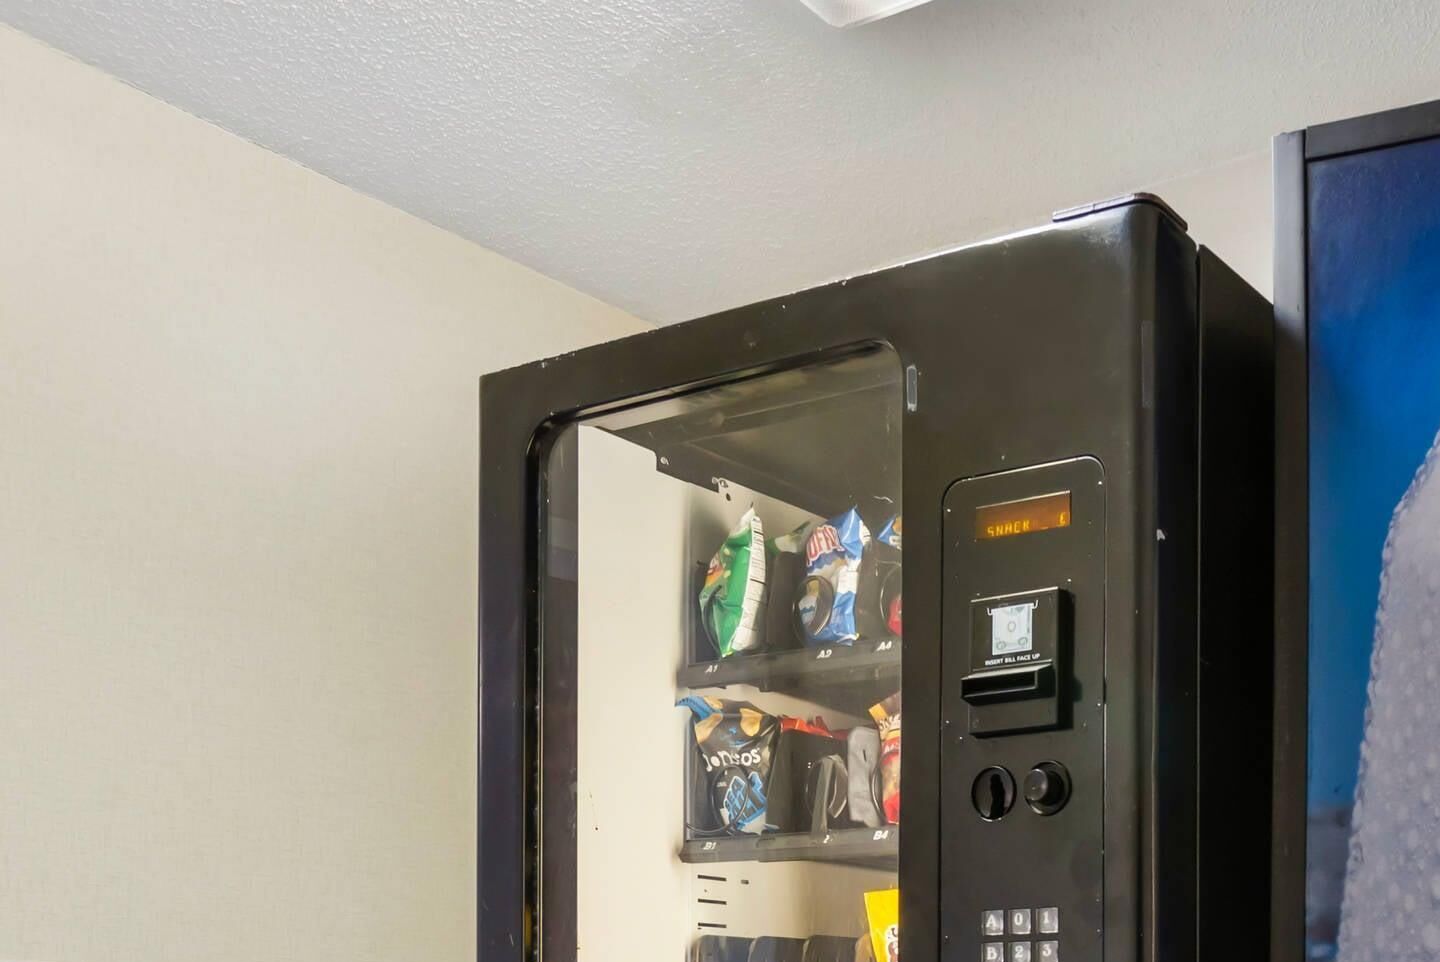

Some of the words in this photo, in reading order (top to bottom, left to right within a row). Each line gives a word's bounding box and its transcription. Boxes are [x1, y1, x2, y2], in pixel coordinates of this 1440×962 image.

[985, 657, 1003, 666] INSERT
[1004, 656, 1016, 664] BILL
[1017, 654, 1031, 662] FACE
[873, 830, 889, 841] B4
[985, 914, 996, 928] A
[1014, 912, 1023, 926] 0
[1043, 911, 1050, 924] 1
[986, 946, 998, 960] B
[1014, 945, 1024, 959] 2
[1042, 944, 1052, 957] 3
